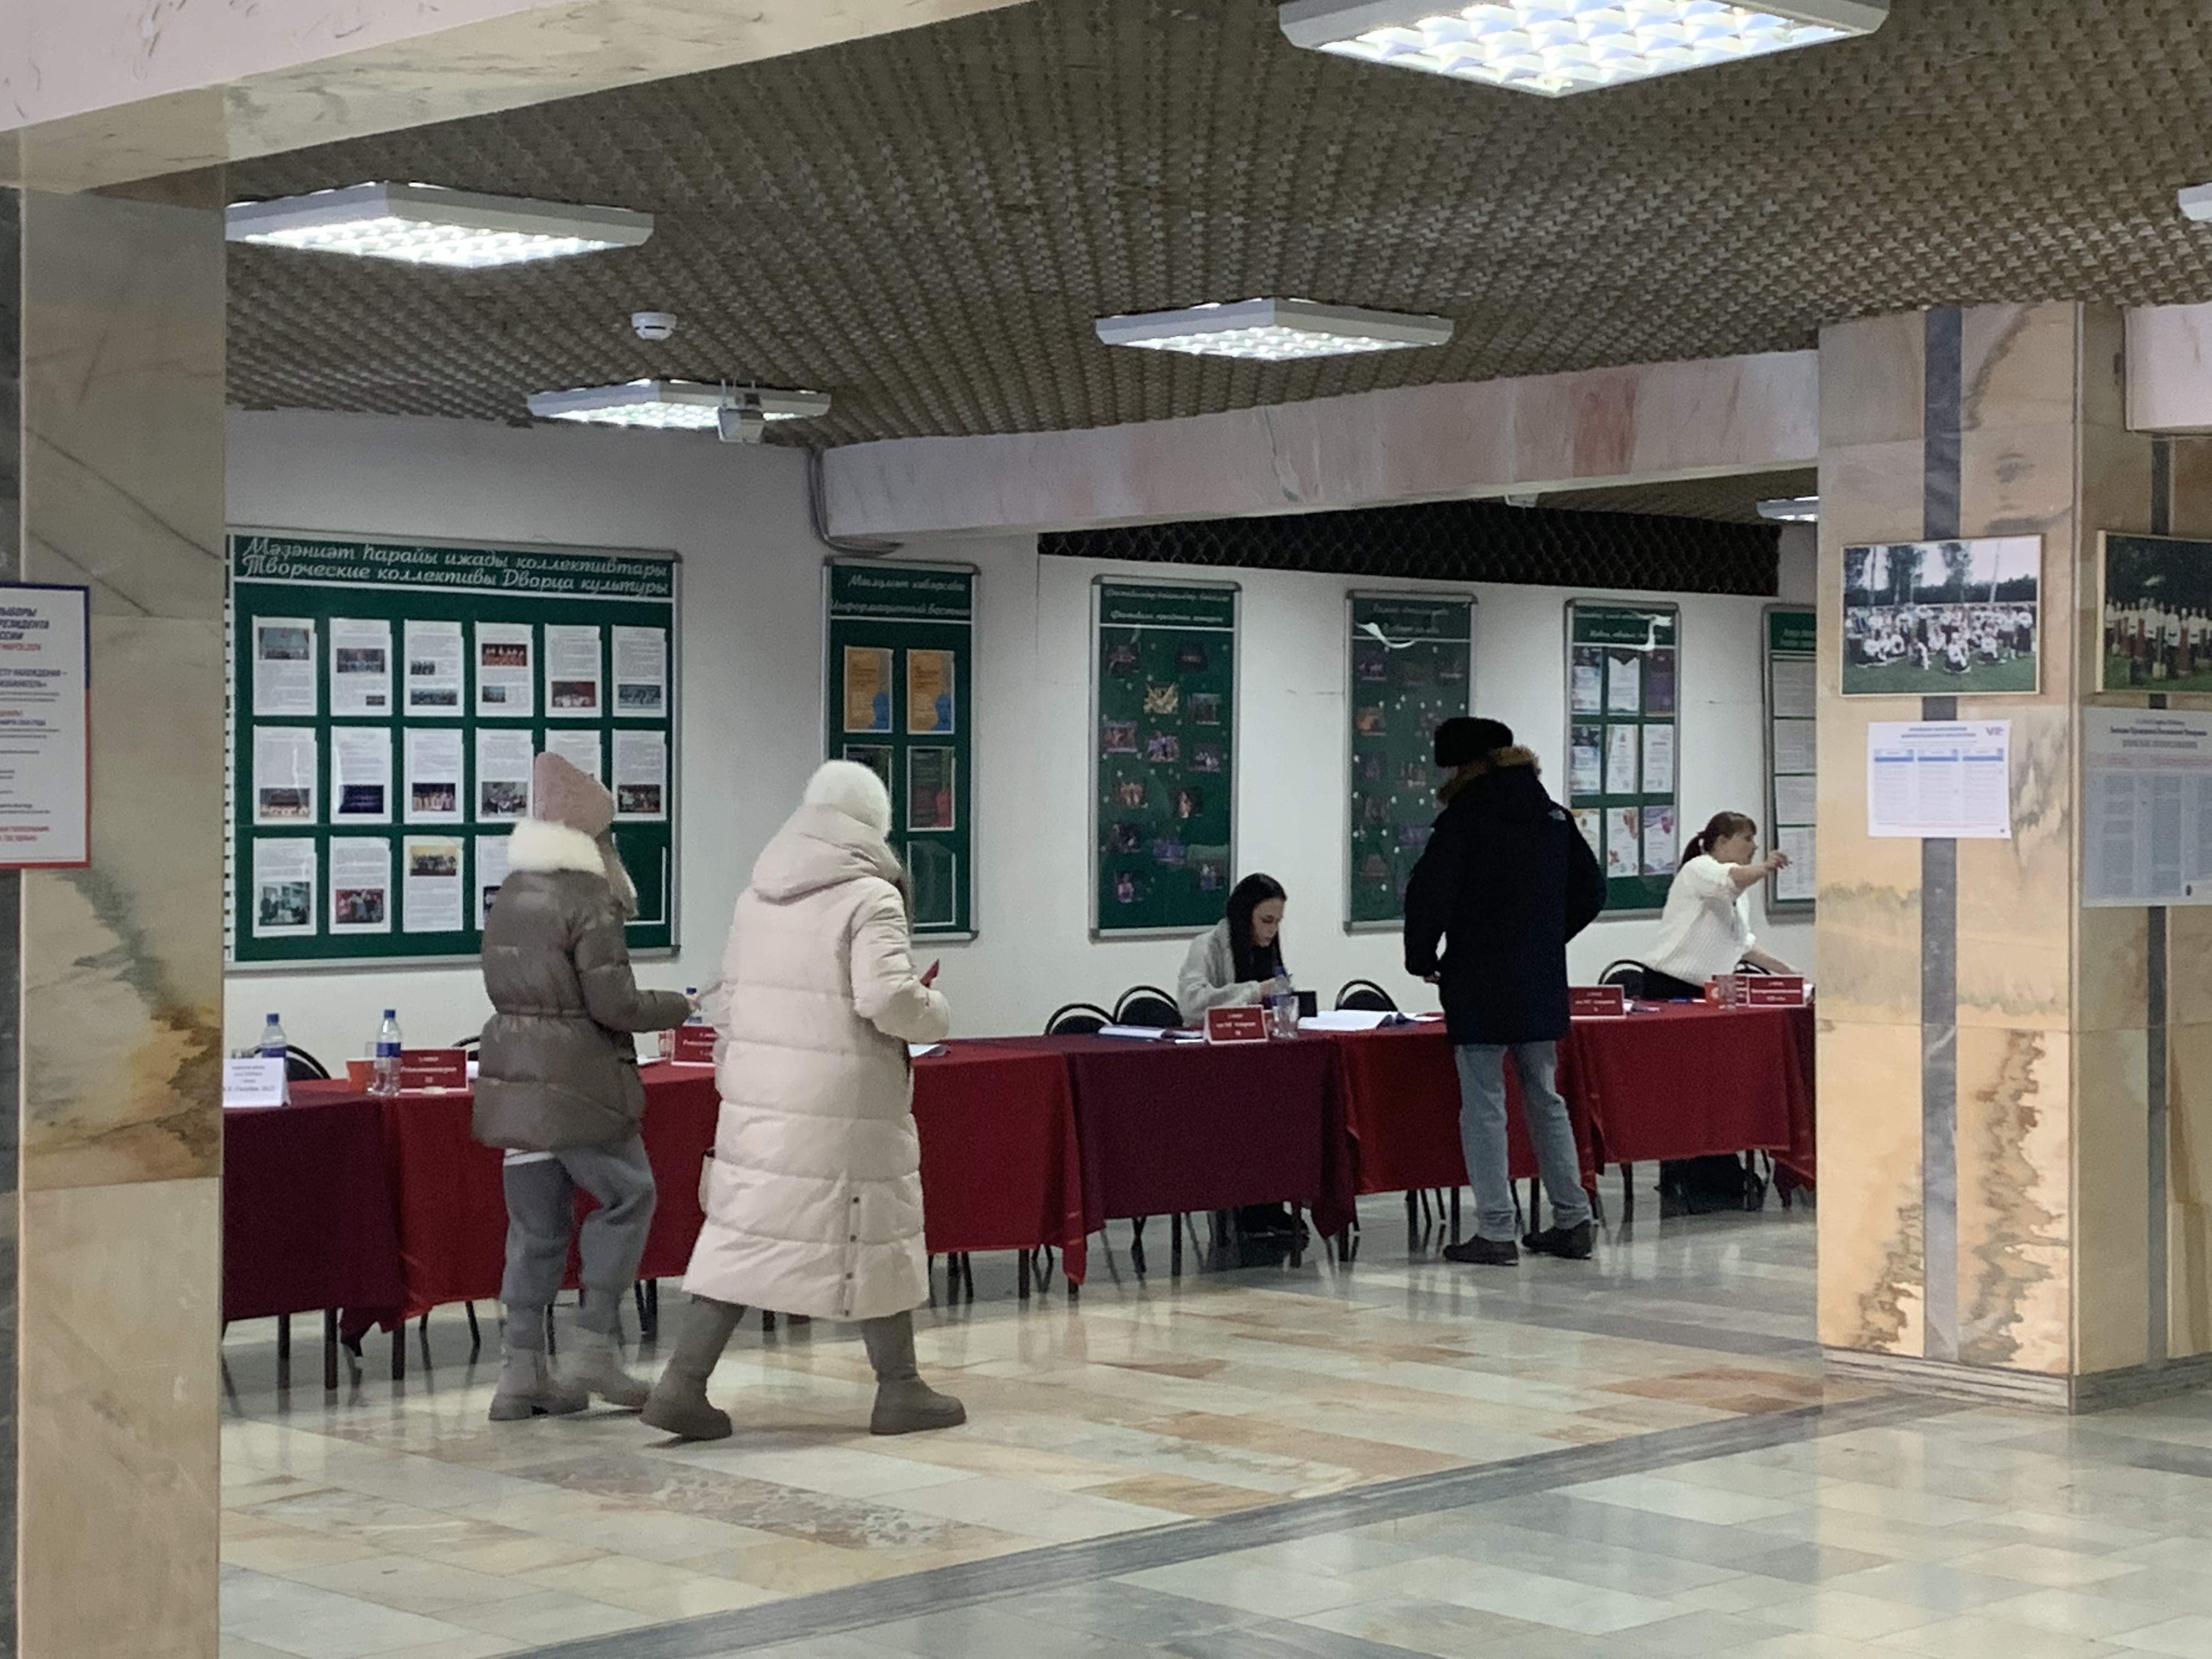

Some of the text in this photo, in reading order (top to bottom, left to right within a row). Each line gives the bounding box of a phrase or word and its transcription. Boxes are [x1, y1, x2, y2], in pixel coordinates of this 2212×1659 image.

[242, 554, 669, 598] Творческие коллективы Дворца культуры
[516, 556, 667, 579] коллективтары
[0, 607, 37, 617] ЫБОРЫ
